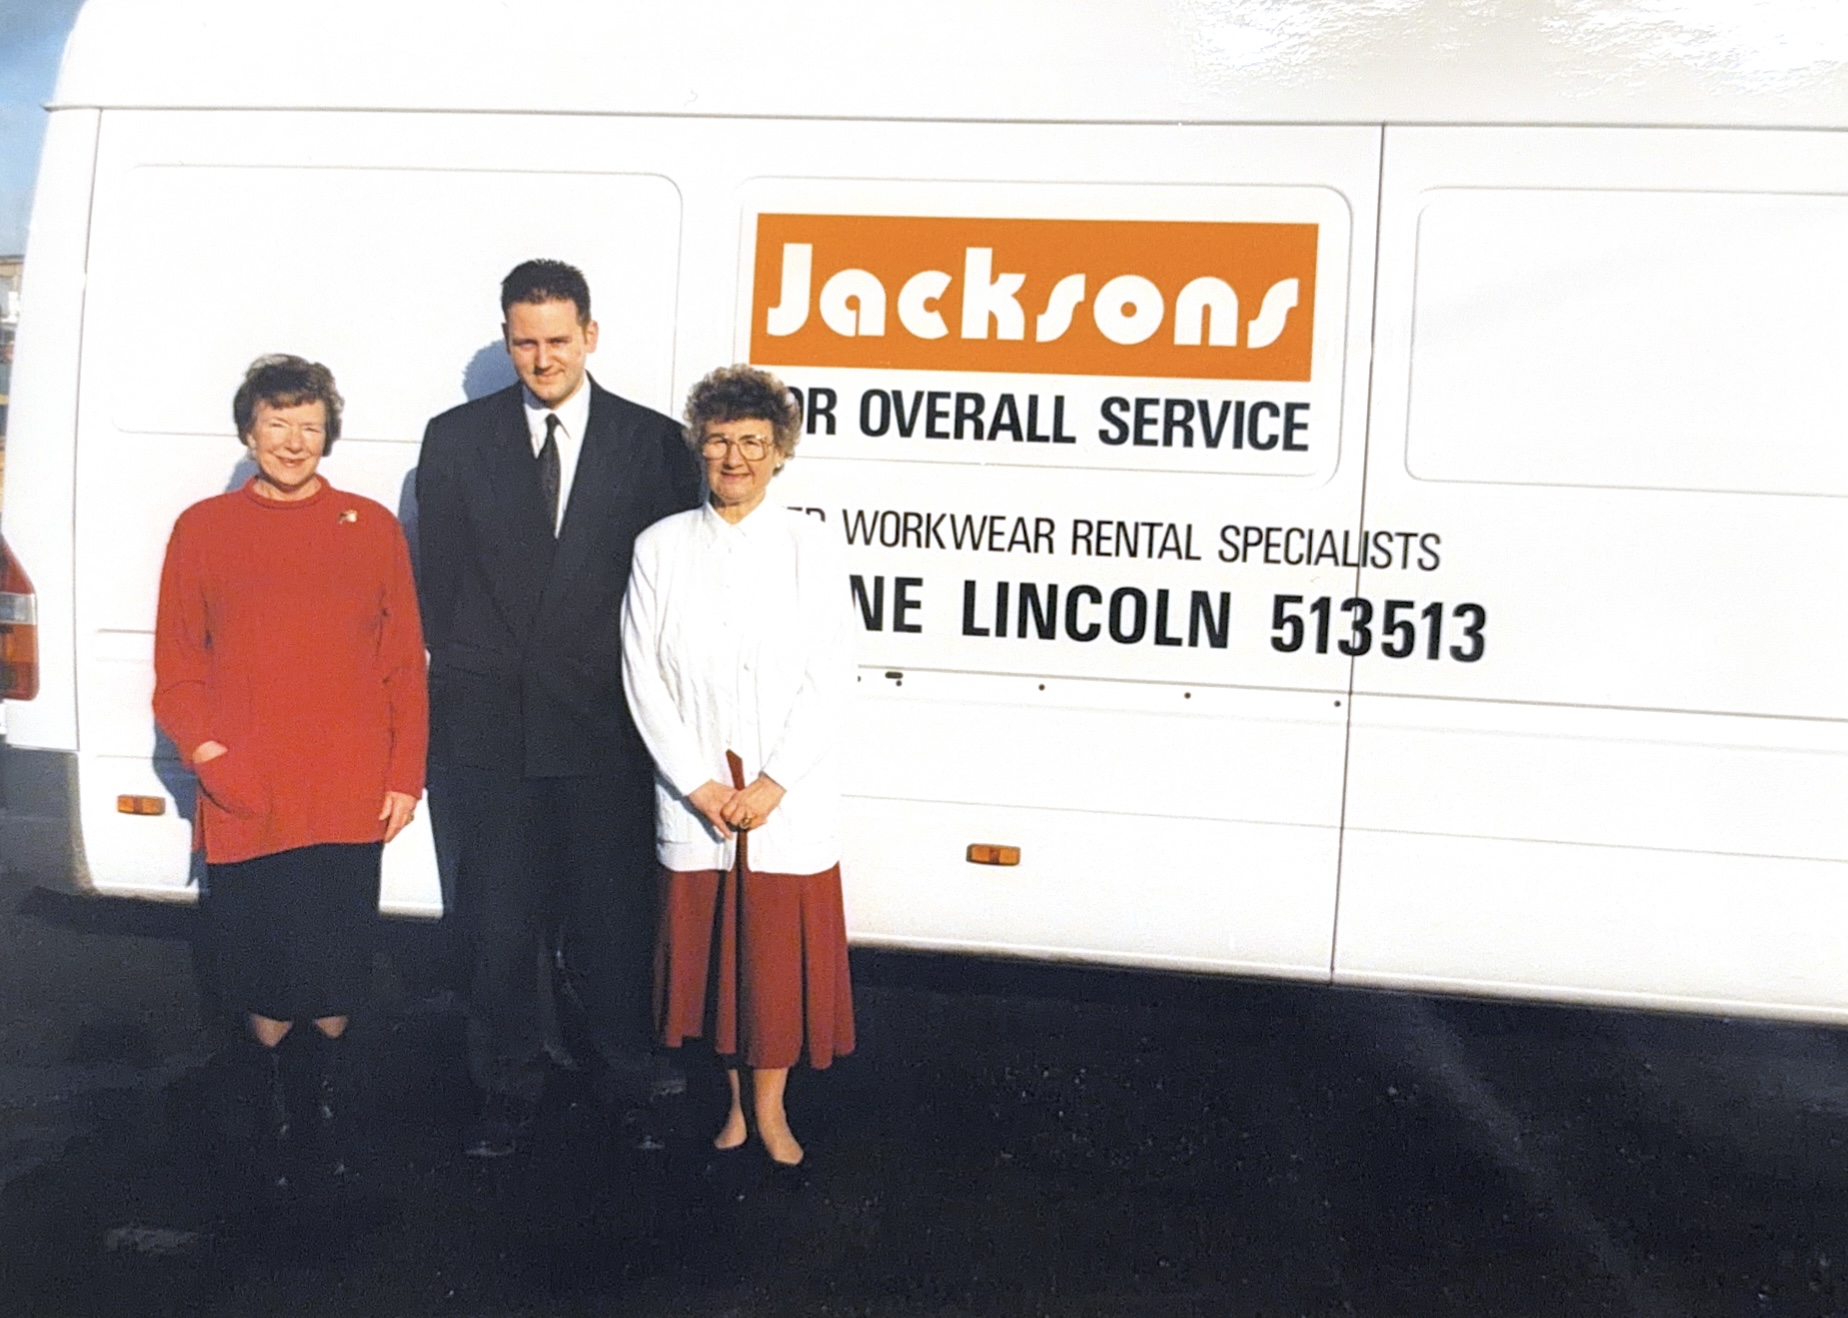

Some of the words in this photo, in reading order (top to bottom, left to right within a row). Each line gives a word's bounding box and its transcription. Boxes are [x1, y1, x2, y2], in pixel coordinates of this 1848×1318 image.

[766, 243, 1300, 350] Jacksons
[859, 388, 1077, 444] OVERALL
[1098, 396, 1311, 453] SERVICE
[842, 508, 1056, 555] WORKWEAR
[1070, 519, 1203, 561] RENTAL
[1217, 524, 1442, 573] SPECIALISTS
[962, 579, 1232, 649] LINCOLN
[1269, 594, 1488, 664] 513513
